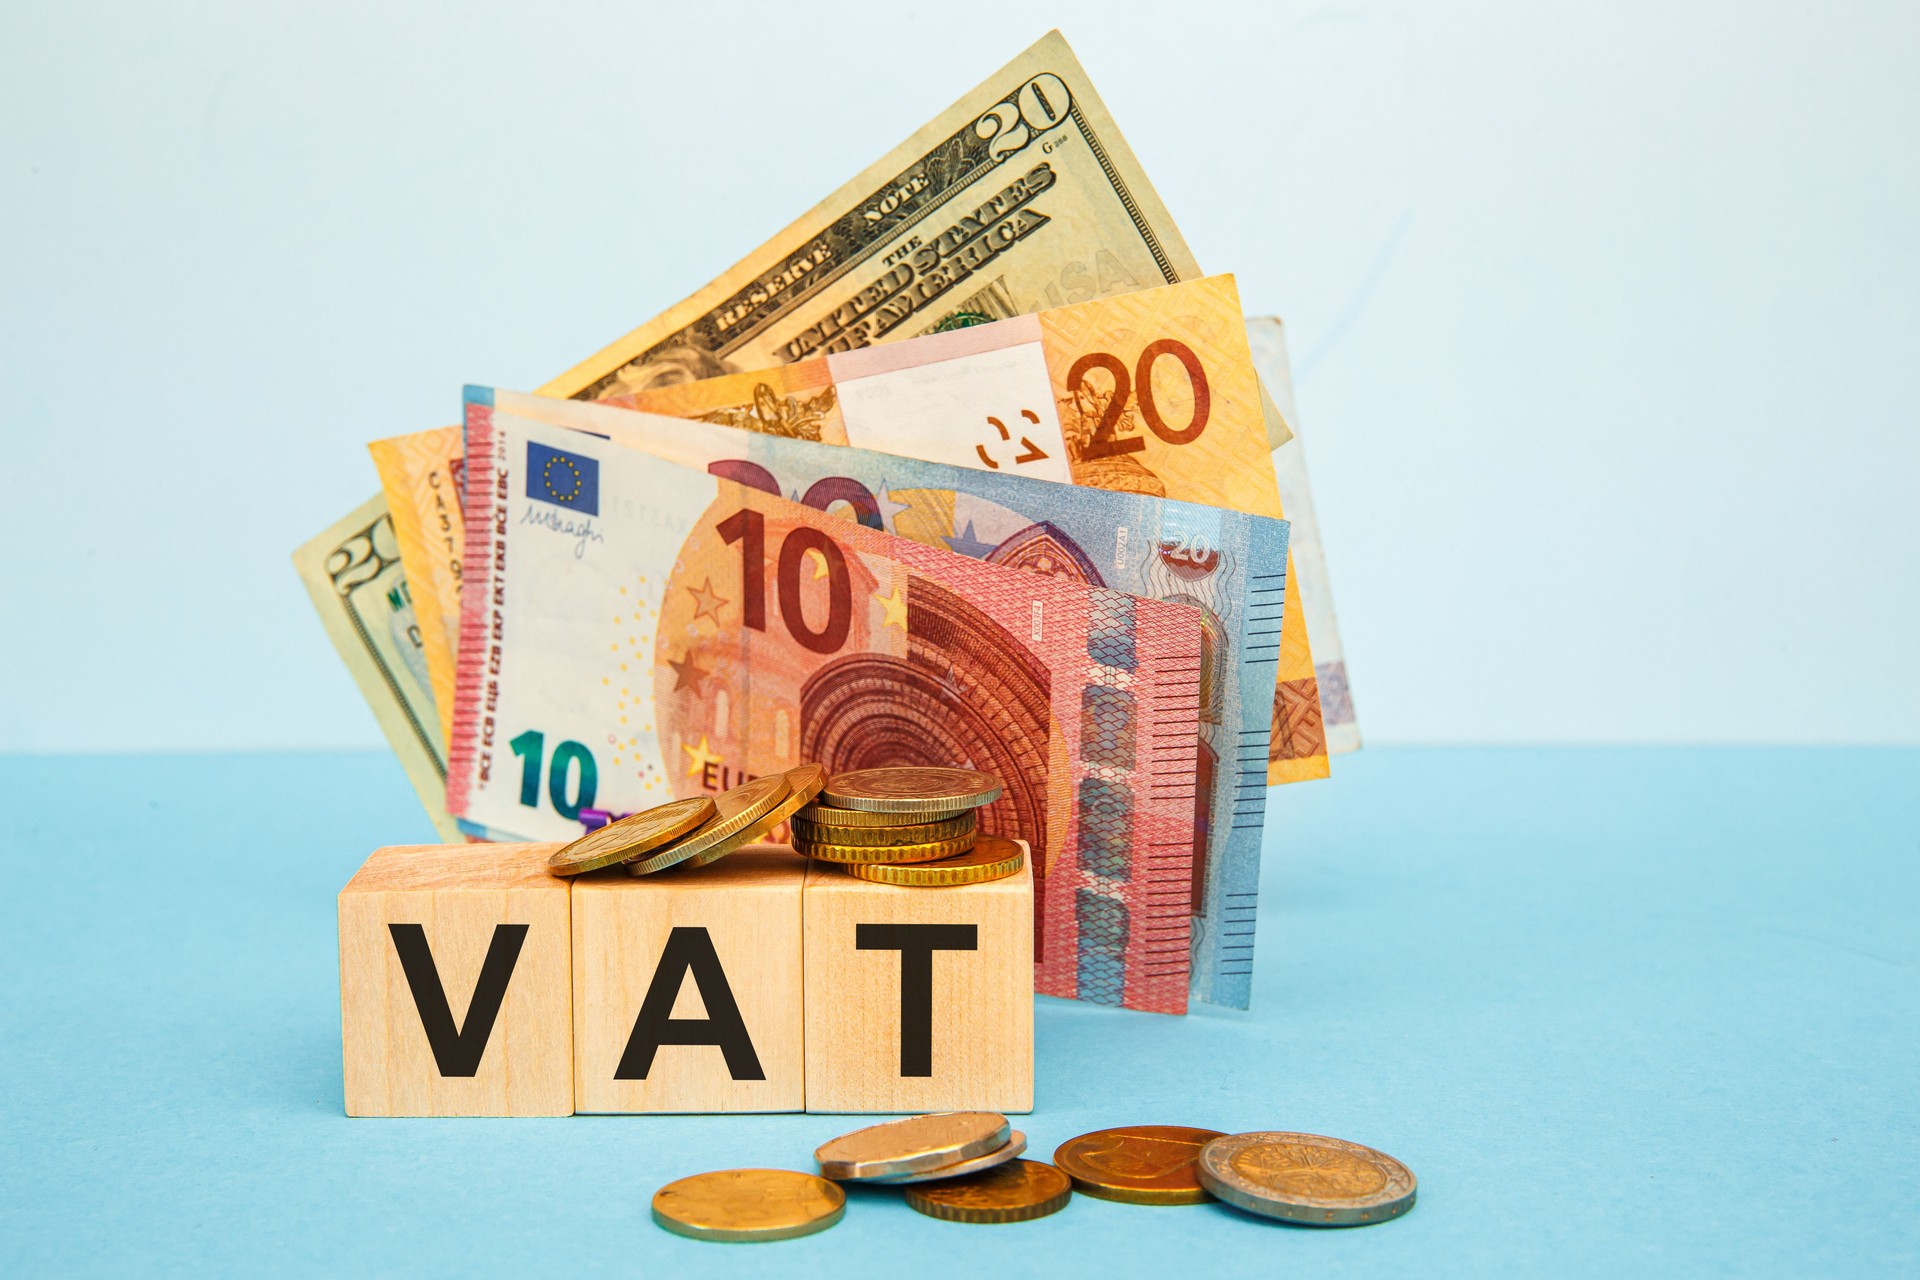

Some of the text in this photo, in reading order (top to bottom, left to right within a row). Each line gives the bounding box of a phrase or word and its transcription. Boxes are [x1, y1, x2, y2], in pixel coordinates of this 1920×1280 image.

[974, 71, 1073, 164] 20
[714, 172, 932, 333] RESERVE NOTE
[772, 161, 1057, 363] UNITED STATES
[872, 208, 1052, 338] AMERICA
[882, 235, 923, 268] THE
[1066, 338, 1211, 462] 20
[492, 575, 505, 606] EKT
[715, 507, 853, 655] 10
[1170, 530, 1211, 564] 20
[491, 609, 504, 641] EKP
[481, 716, 495, 748] ECB
[509, 729, 598, 822] 10
[702, 761, 760, 792] EU
[388, 923, 978, 1081] VAT
